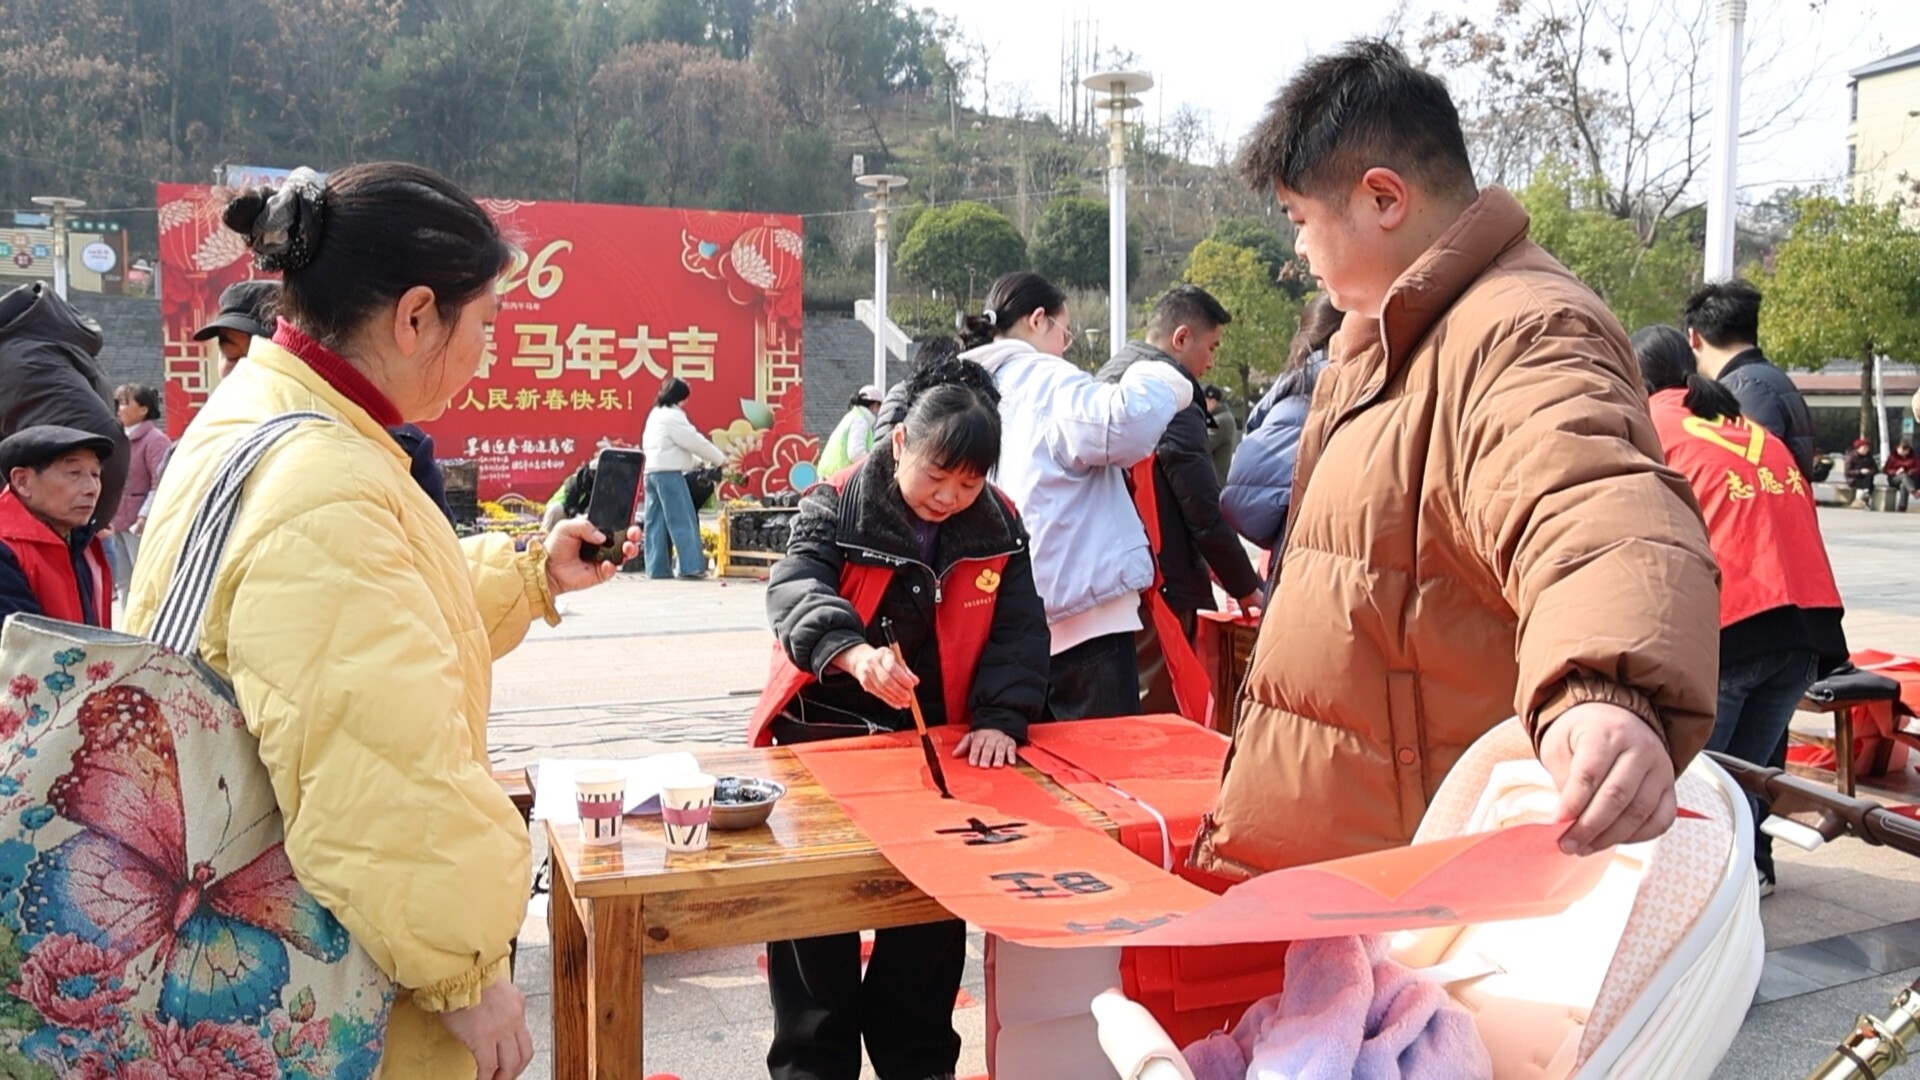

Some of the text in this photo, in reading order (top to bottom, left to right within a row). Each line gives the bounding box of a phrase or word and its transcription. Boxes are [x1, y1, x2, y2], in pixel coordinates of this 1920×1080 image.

[511, 323, 719, 382] 马年大吉
[446, 387, 633, 412] 人民新春快乐！
[1725, 465, 1806, 503] 志愿者
